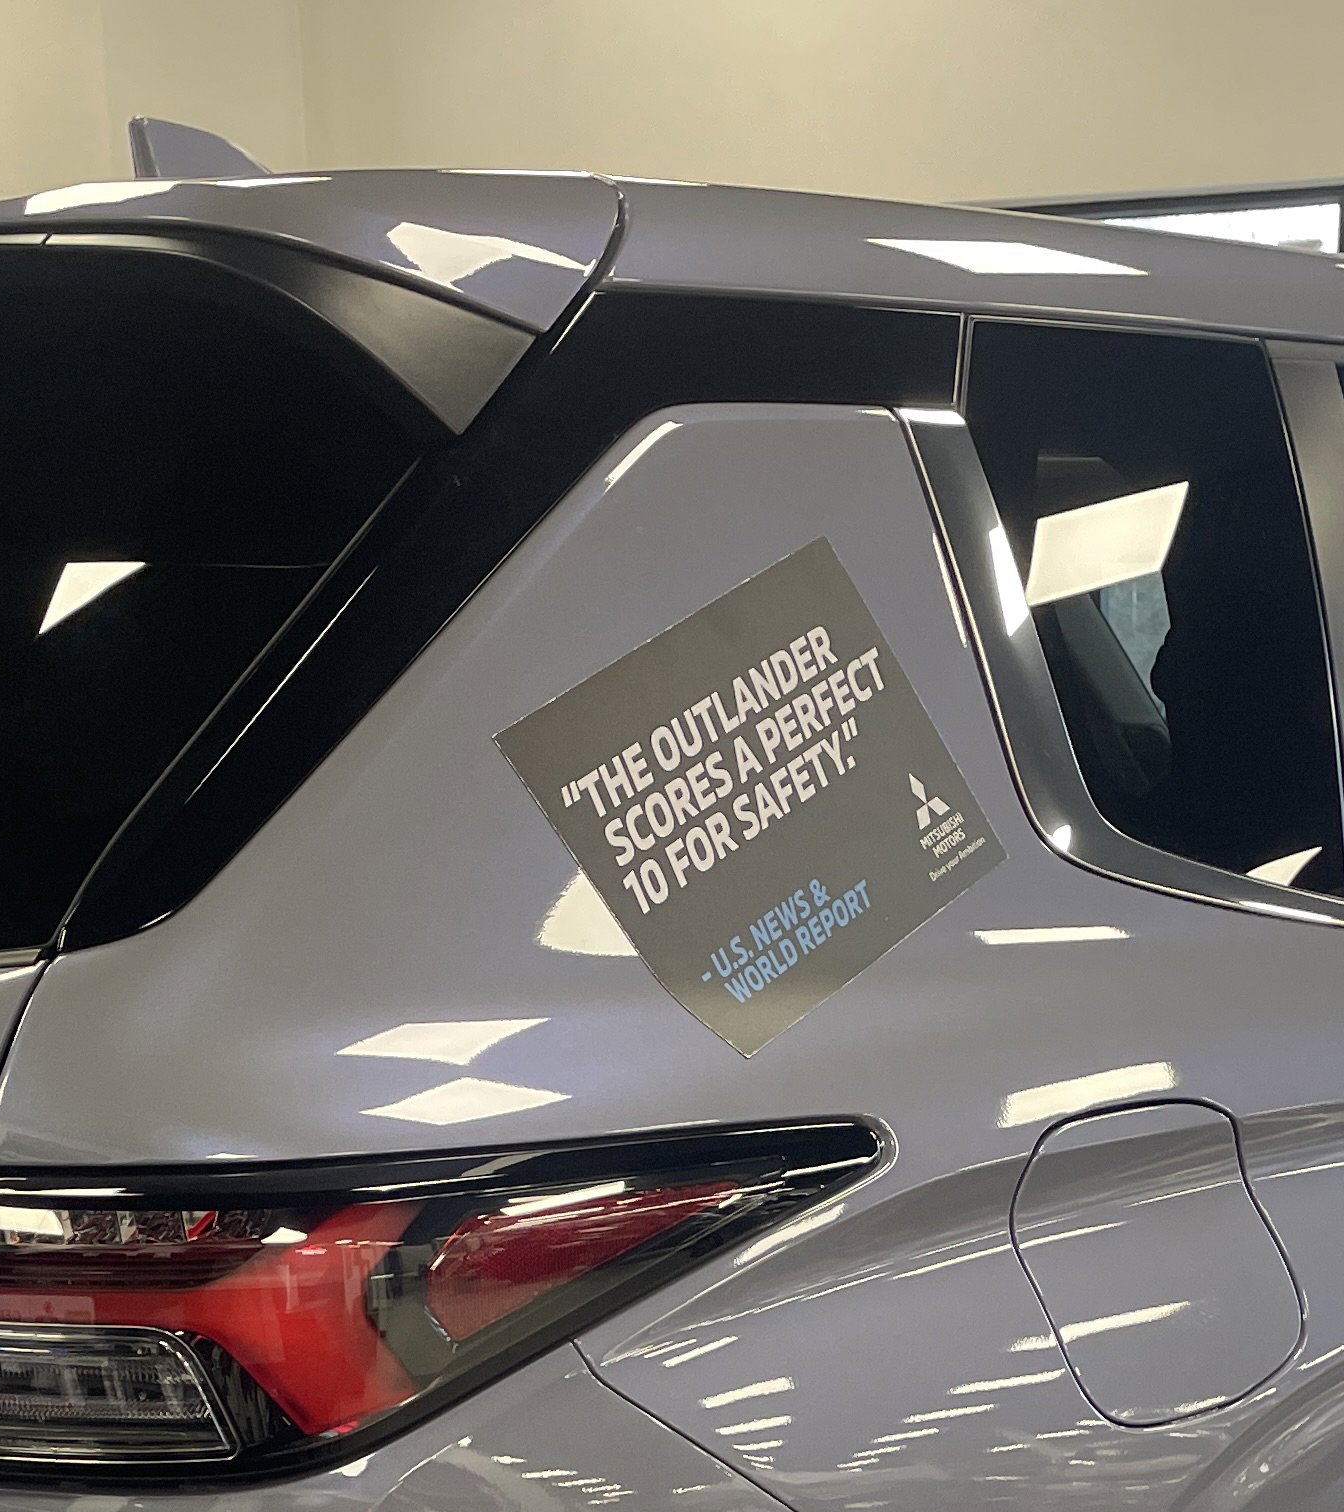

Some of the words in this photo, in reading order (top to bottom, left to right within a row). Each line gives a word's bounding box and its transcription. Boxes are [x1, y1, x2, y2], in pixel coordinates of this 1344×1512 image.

[650, 625, 838, 772] OUTLANDER
[604, 751, 734, 867] SCORES
[733, 735, 764, 784] A
[755, 646, 885, 764] PERFECT
[622, 858, 669, 915] 10
[665, 811, 739, 888] FOR
[919, 811, 965, 850] MITSUBISHI
[932, 827, 966, 859] MOTORS
[710, 935, 755, 979] U.S.
[749, 888, 811, 951] NEWS
[809, 878, 831, 907] &
[724, 937, 798, 1004] WORLD
[795, 879, 872, 955] REPORT
